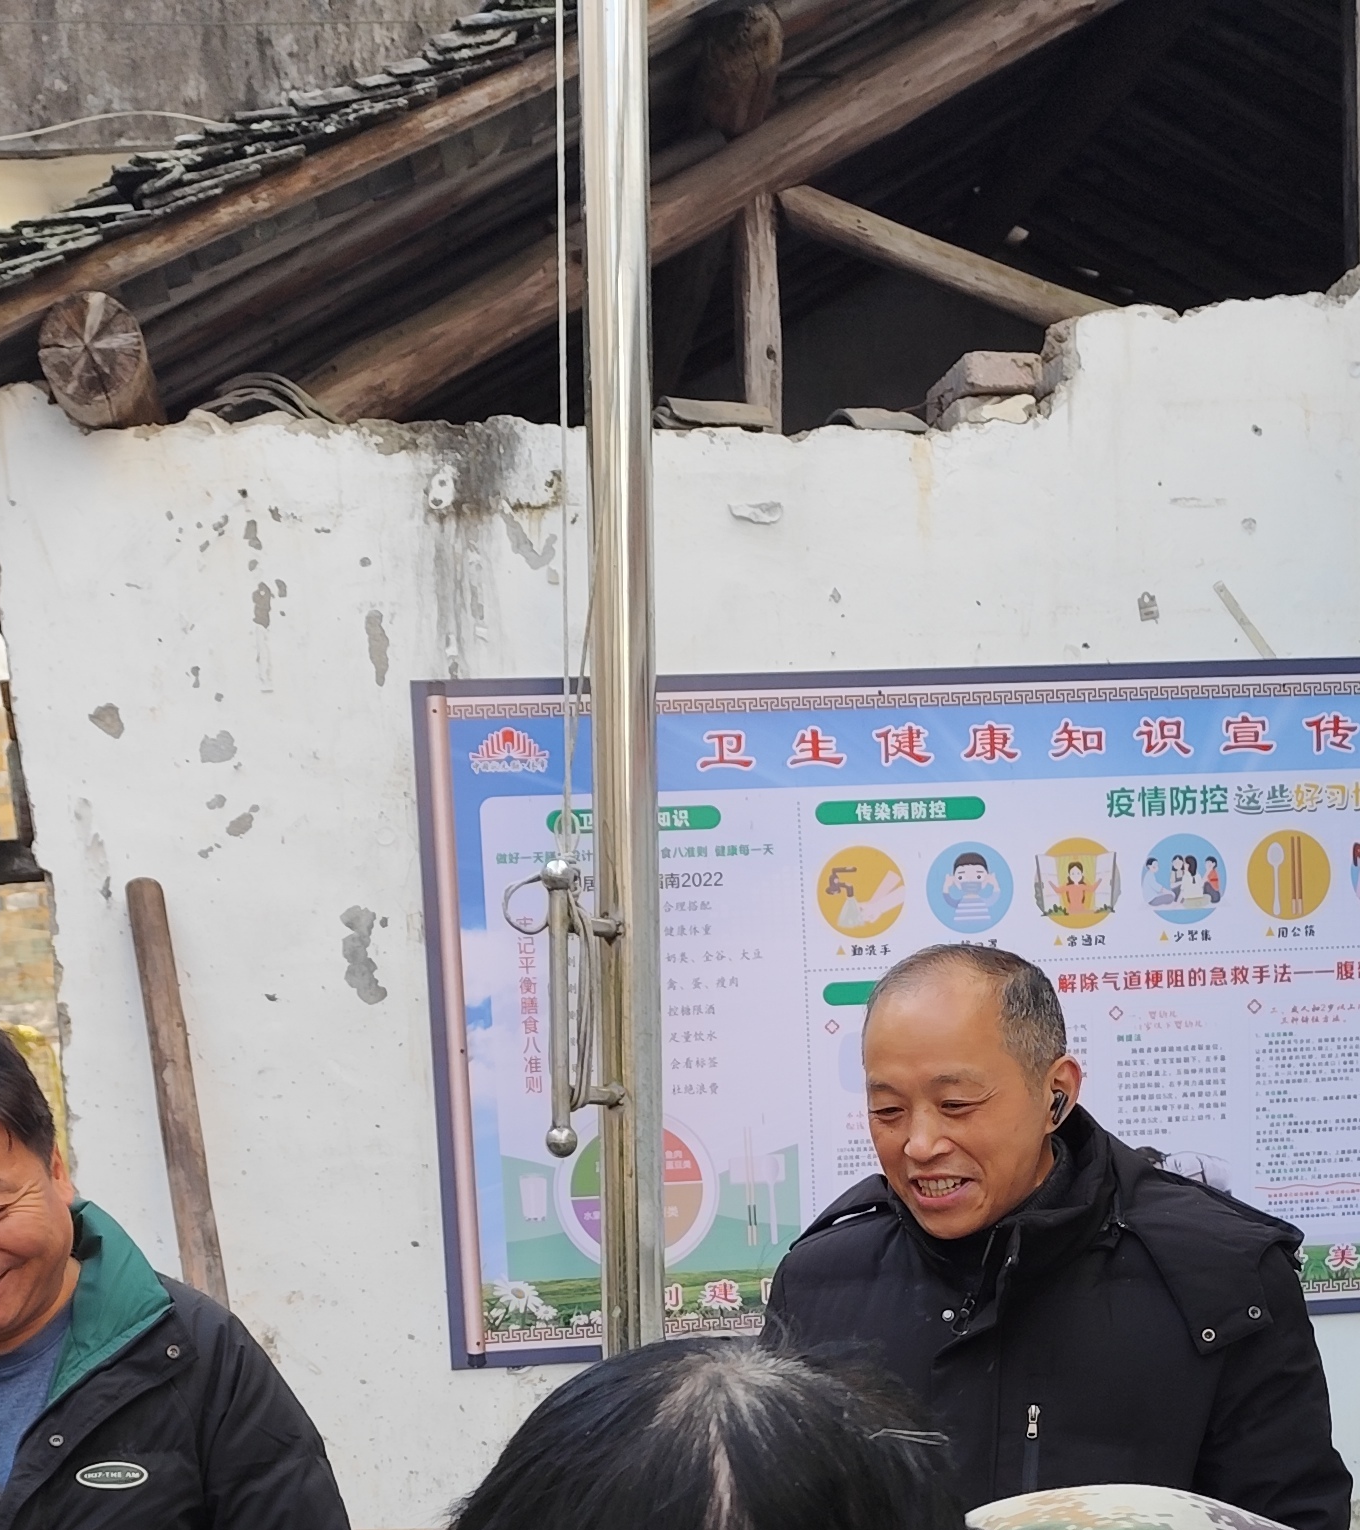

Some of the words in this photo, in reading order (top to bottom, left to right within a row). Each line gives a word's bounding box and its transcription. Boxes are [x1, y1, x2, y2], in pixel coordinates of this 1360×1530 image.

[855, 799, 947, 822] 传染病防控
[714, 843, 774, 858] 健康每一天
[663, 900, 713, 913] 合理搭配
[664, 923, 713, 937] 健康体重
[1173, 928, 1213, 943] 少聚集
[1277, 924, 1316, 939] 用公筷
[1066, 934, 1107, 948] 常通风
[850, 943, 892, 957] 勤洗手
[667, 1003, 716, 1017] 控糖限酒
[669, 1030, 718, 1044] 足量饮水
[670, 1056, 719, 1070] 会看标签
[672, 1082, 719, 1095] 杜绝浪费
